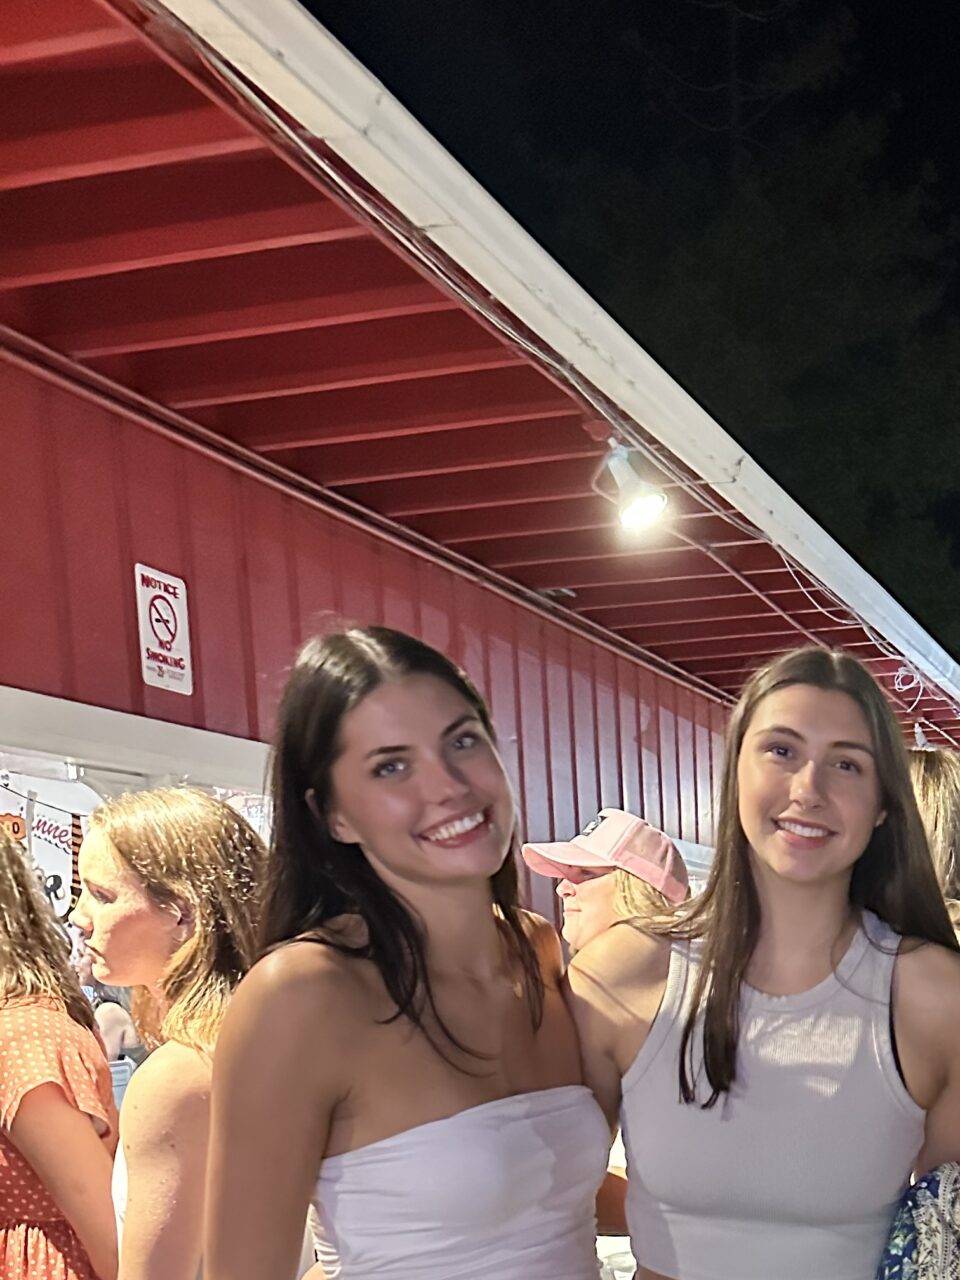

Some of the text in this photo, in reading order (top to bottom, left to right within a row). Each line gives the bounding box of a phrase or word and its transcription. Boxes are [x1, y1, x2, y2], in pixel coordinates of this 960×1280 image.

[140, 573, 180, 599] NOTICE
[159, 640, 172, 651] NO
[146, 647, 185, 670] SMOKING
